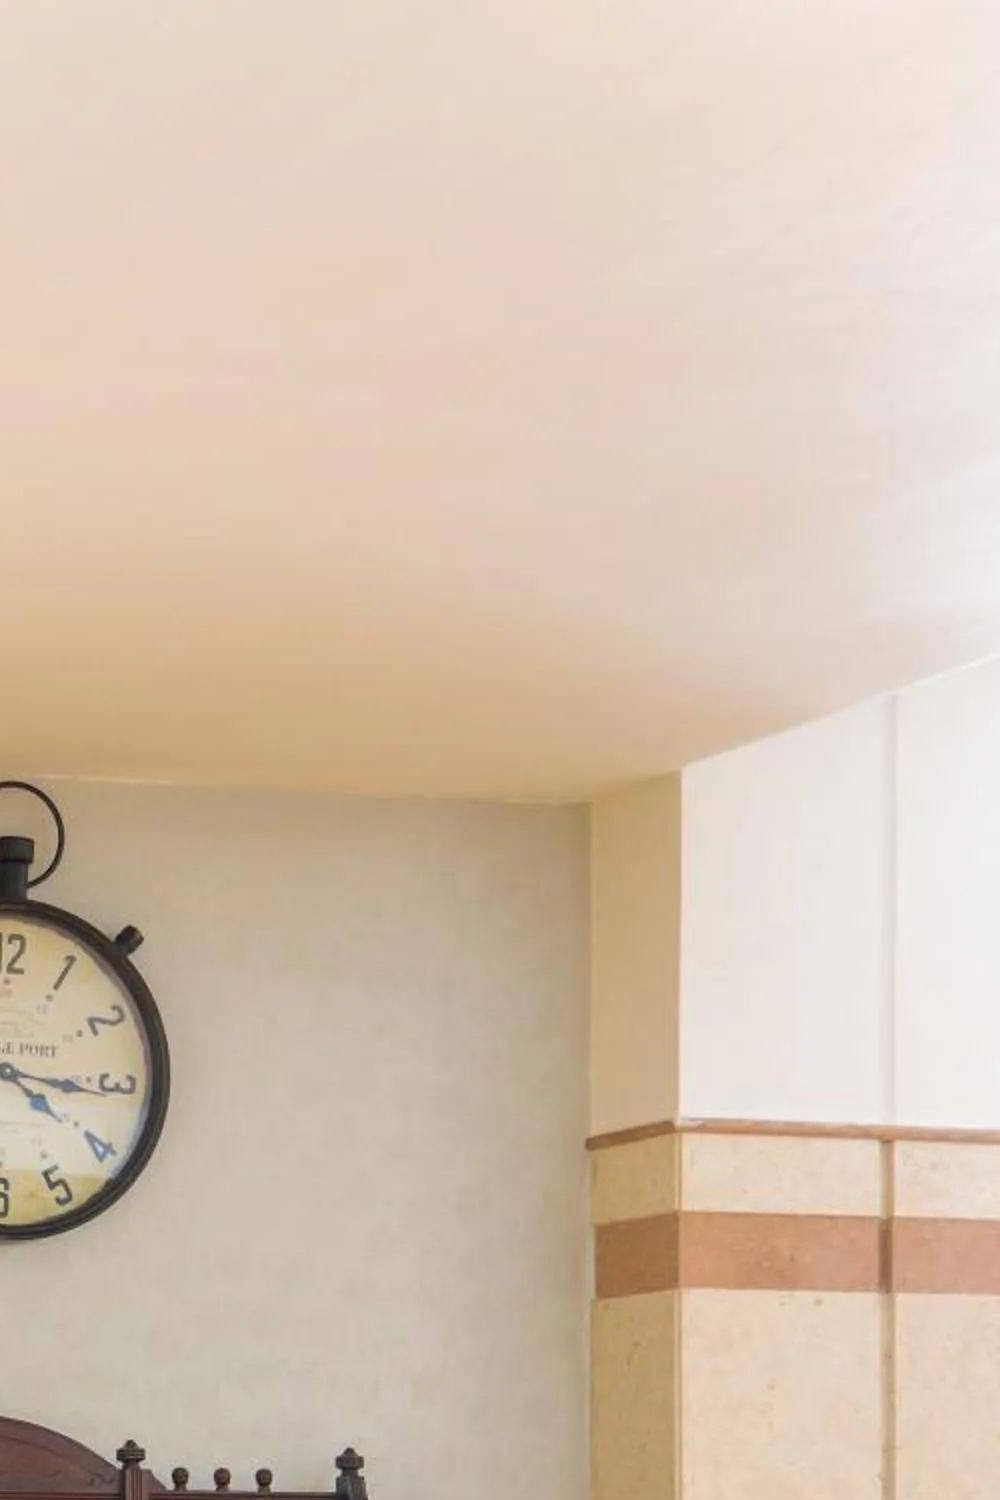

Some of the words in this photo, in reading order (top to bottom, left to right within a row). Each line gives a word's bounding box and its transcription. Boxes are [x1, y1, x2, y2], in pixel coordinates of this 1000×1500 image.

[54, 955, 76, 990] 1
[87, 1006, 124, 1035] 2
[99, 1073, 136, 1094] 3
[84, 1131, 116, 1163] 4
[42, 1166, 72, 1206] 5
